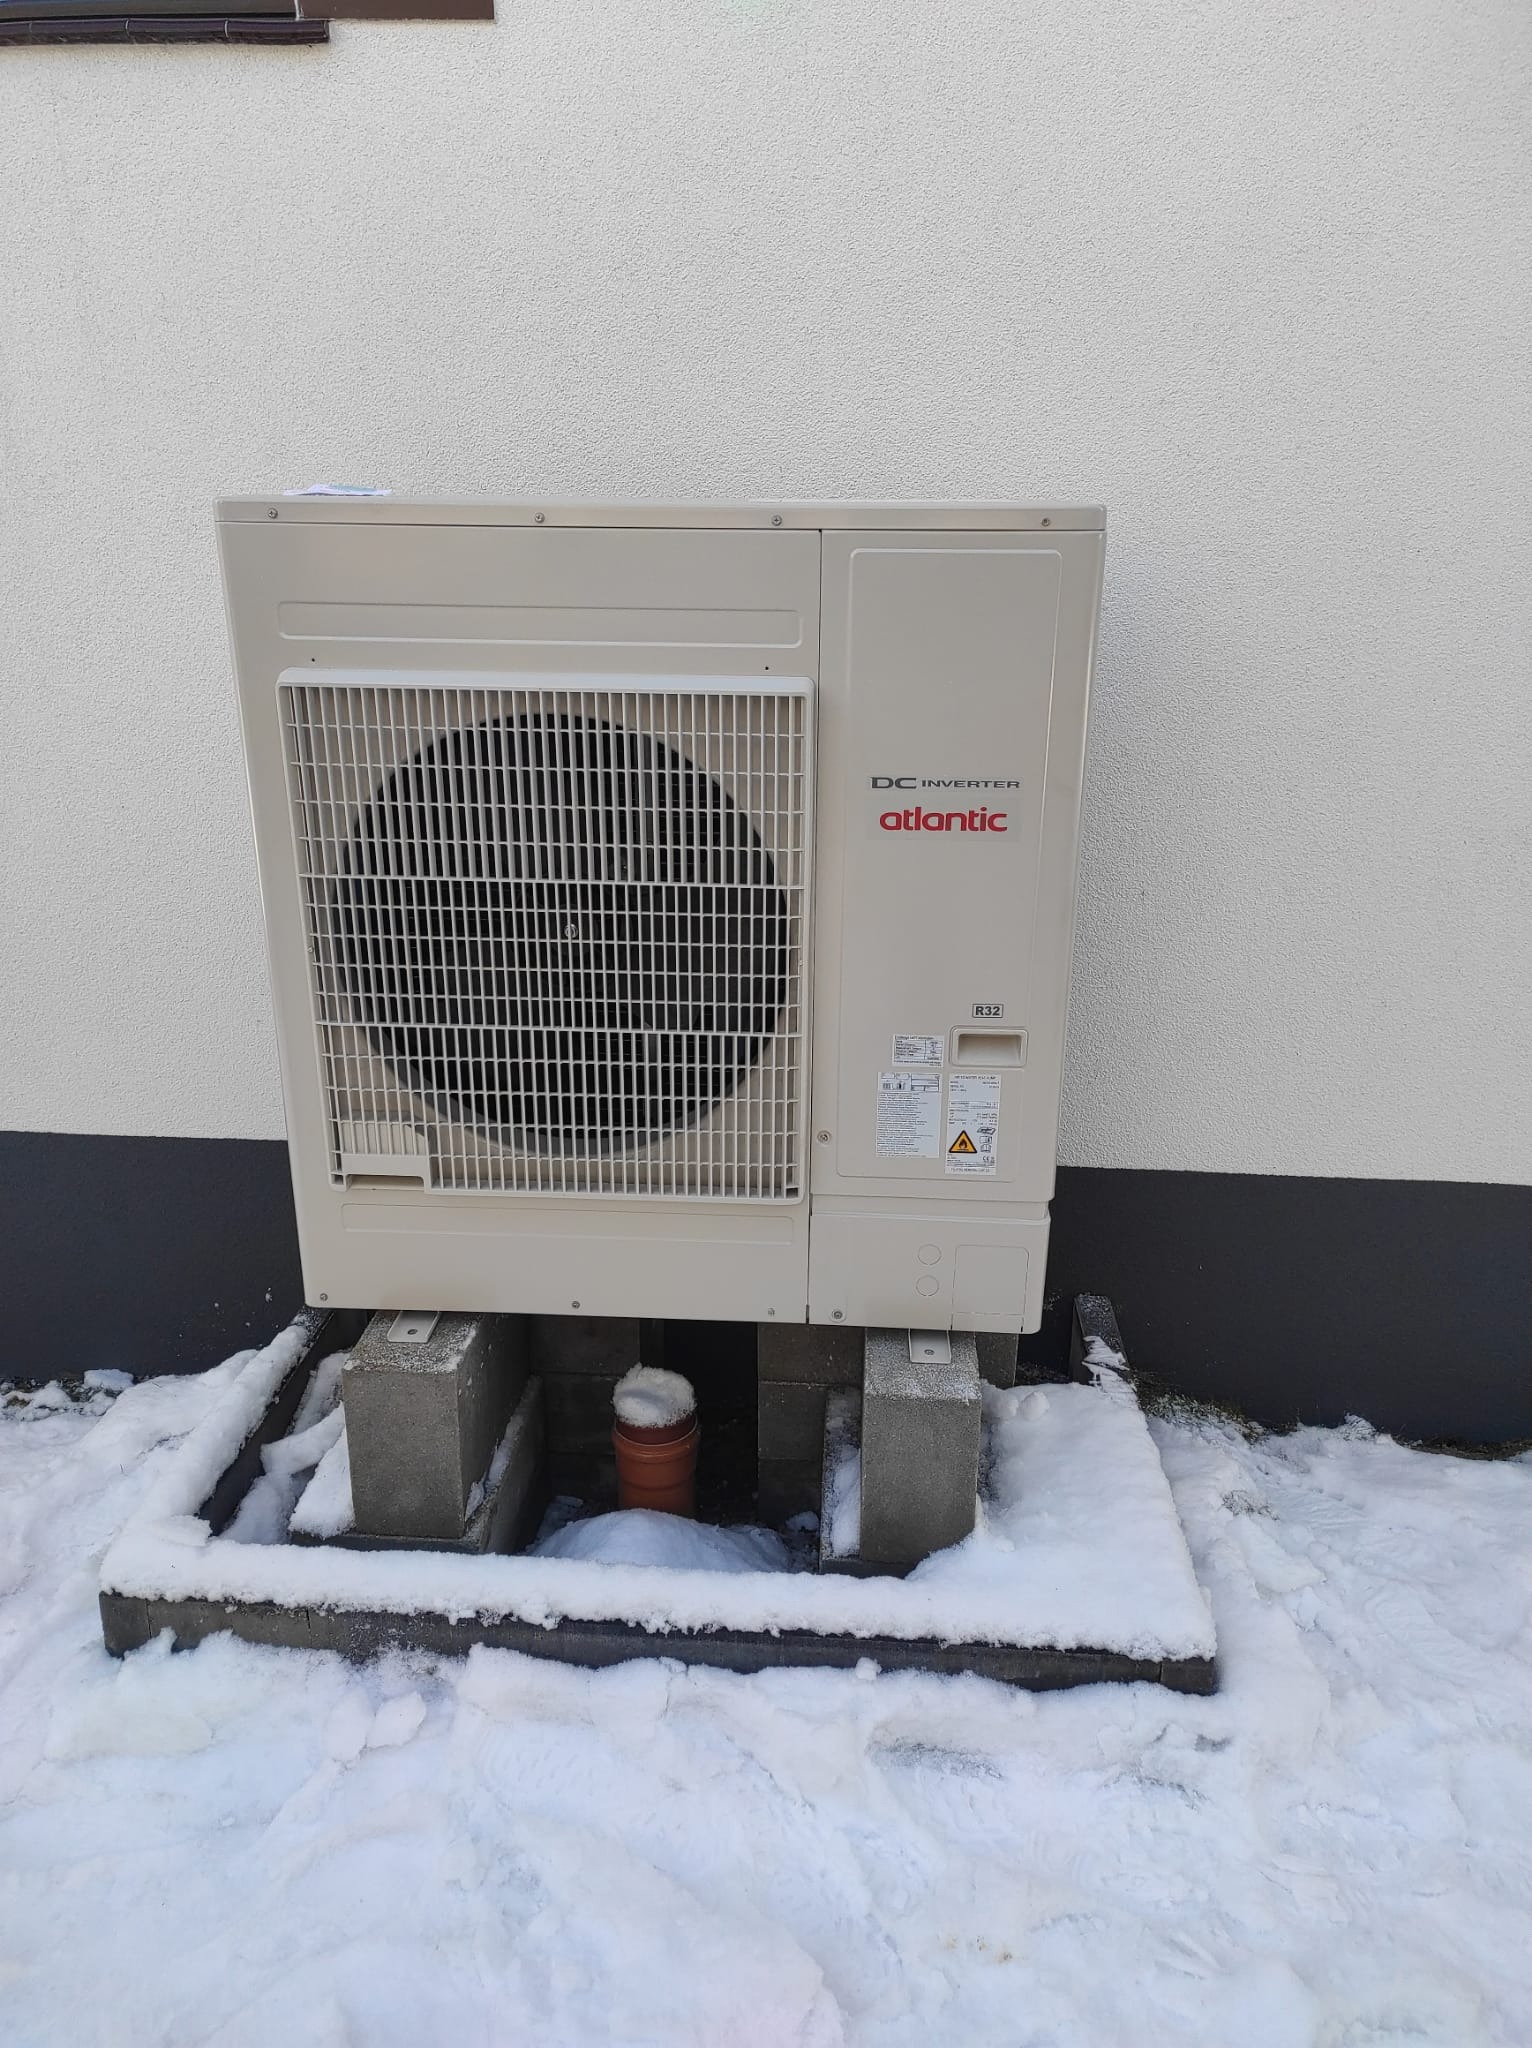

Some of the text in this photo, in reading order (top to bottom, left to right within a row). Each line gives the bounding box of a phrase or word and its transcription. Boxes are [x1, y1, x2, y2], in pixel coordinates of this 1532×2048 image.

[871, 777, 1020, 789] DC INVERTER
[879, 806, 1008, 832] atlantic
[975, 1006, 1001, 1016] R32
